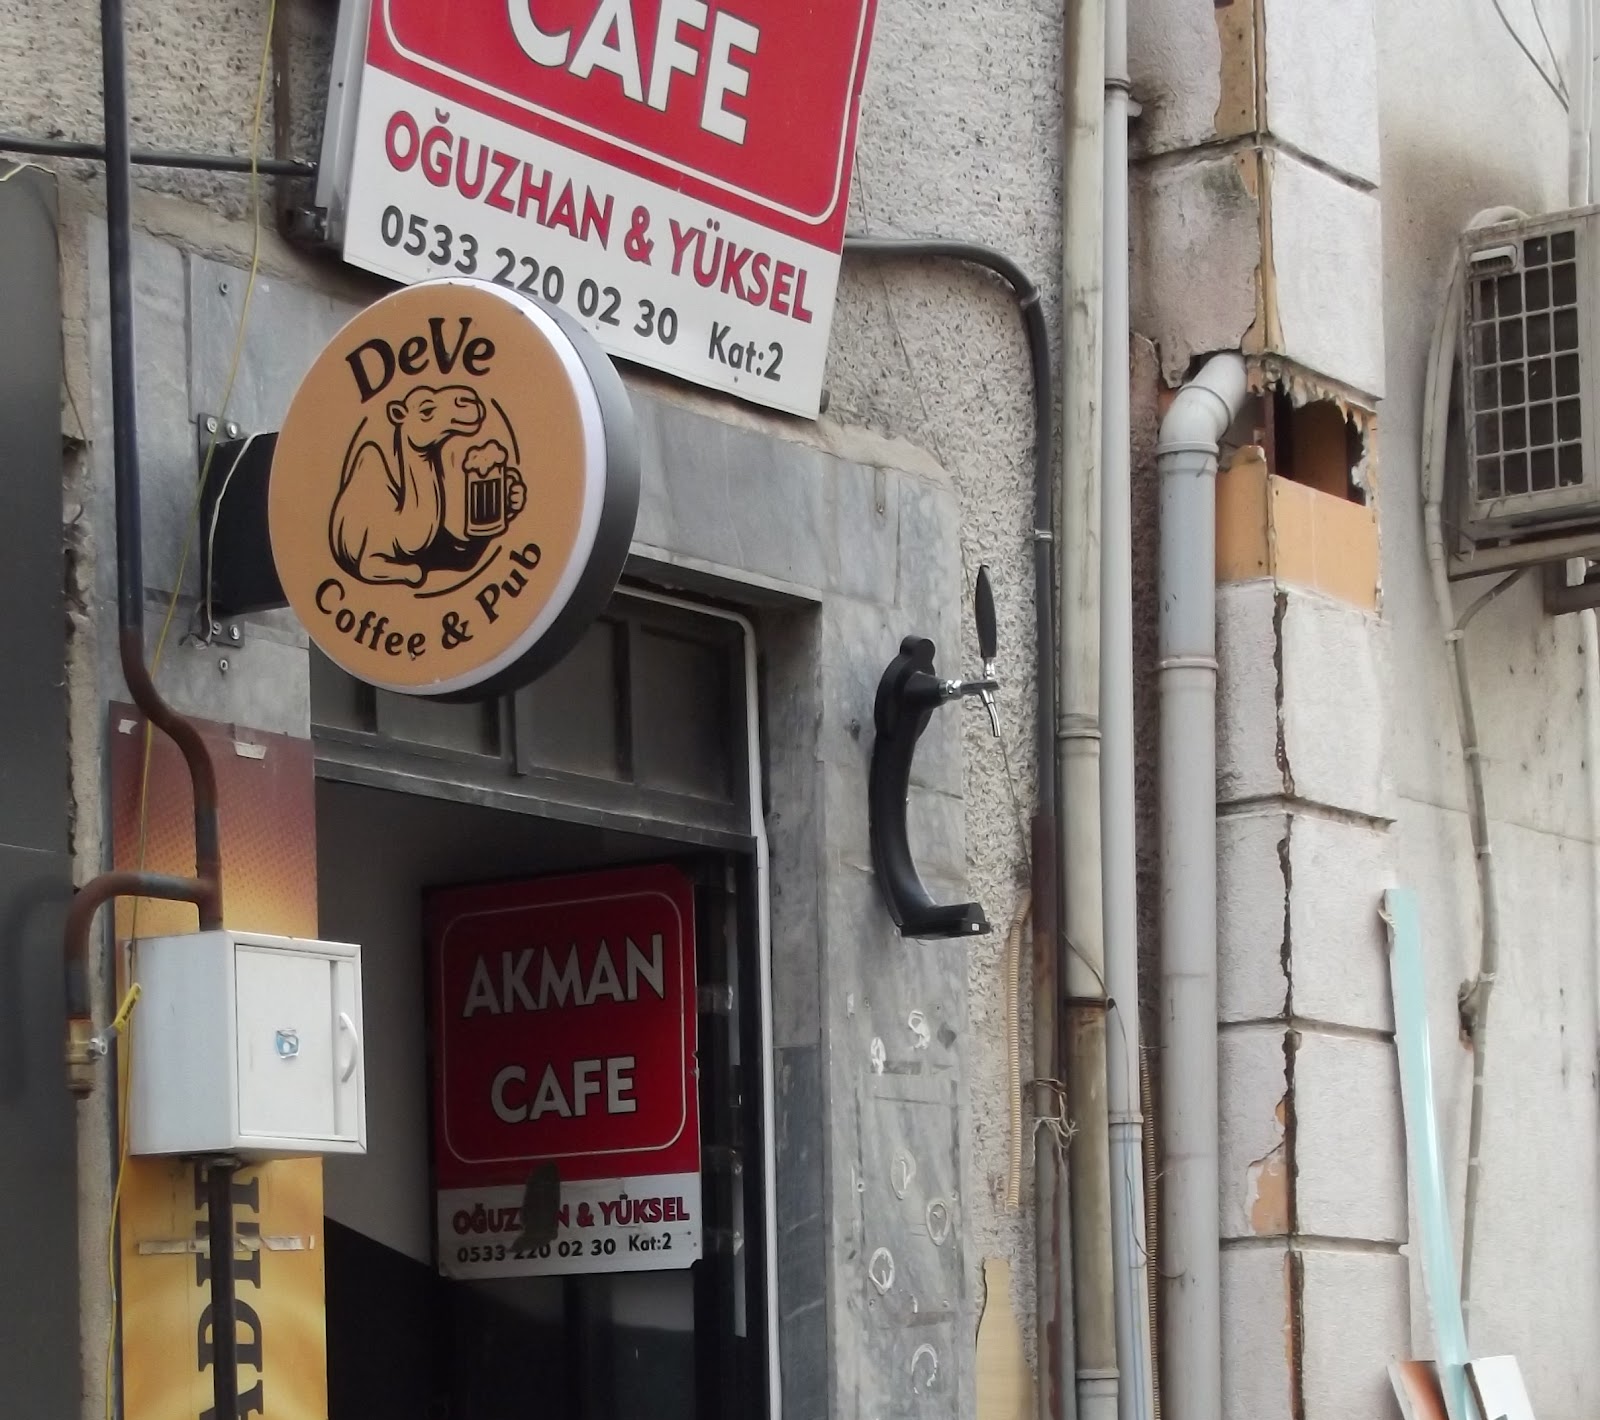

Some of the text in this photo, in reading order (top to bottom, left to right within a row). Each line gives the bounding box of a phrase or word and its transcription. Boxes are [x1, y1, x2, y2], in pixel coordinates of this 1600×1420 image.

[507, 0, 760, 146] CAFE
[385, 108, 814, 324] OĞUZHAN & YÜKSEL
[381, 205, 784, 382] 0533 220 02 30 Kat:2
[345, 317, 496, 404] DeVe
[315, 540, 542, 657] Coffee & Pub
[462, 934, 664, 1018] AKMAN
[491, 1056, 637, 1124] CAFE
[453, 1193, 691, 1236] OĞUZN & YÜKSEL
[457, 1245, 506, 1263] 0533
[558, 1240, 584, 1258] 02
[591, 1238, 617, 1257] 30
[628, 1232, 673, 1252] Kat:2
